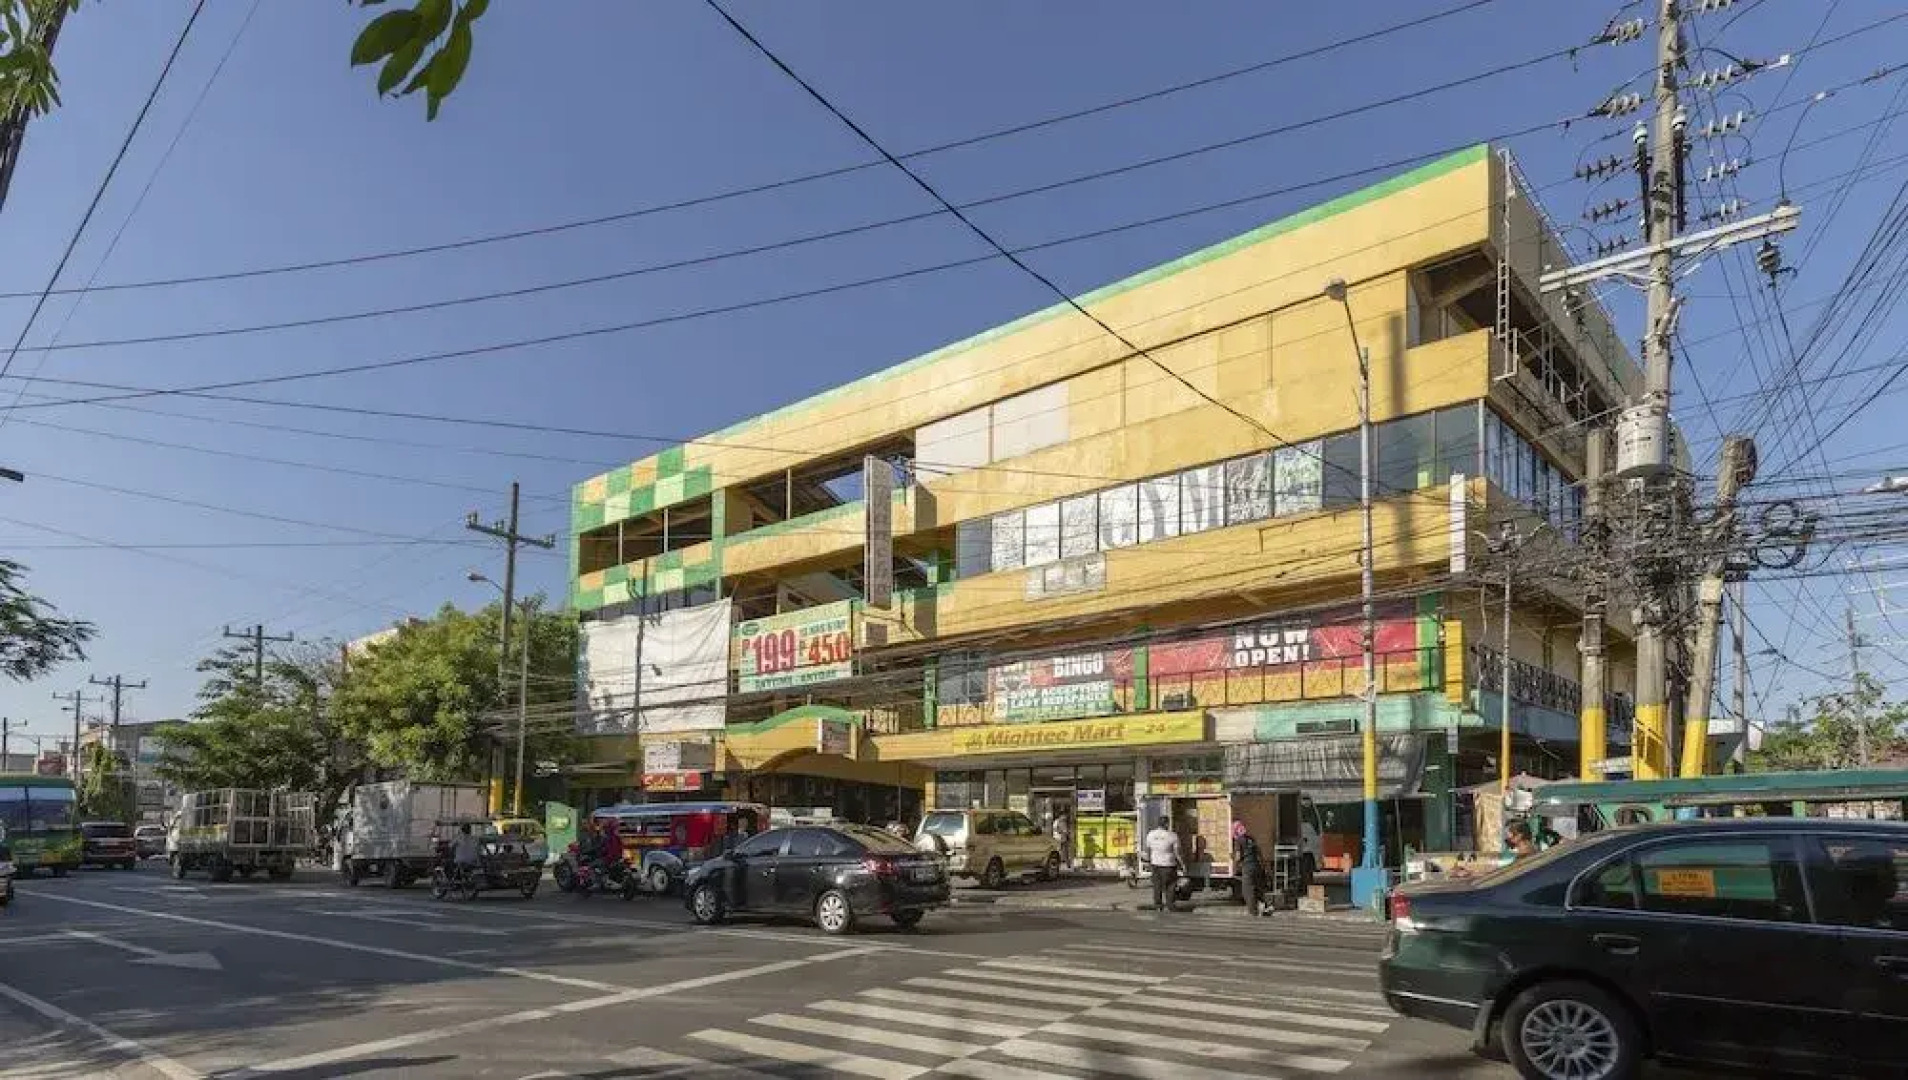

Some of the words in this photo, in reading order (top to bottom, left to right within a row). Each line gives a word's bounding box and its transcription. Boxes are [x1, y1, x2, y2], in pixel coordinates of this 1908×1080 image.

[1235, 619, 1308, 650] NOW
[752, 629, 794, 675] 199
[808, 632, 850, 665] 450
[1235, 644, 1309, 667] OPEN!
[1053, 652, 1104, 678] BINGO
[986, 729, 1069, 747] Mightee
[1074, 723, 1125, 741] Mart
[1144, 723, 1166, 734] 24
